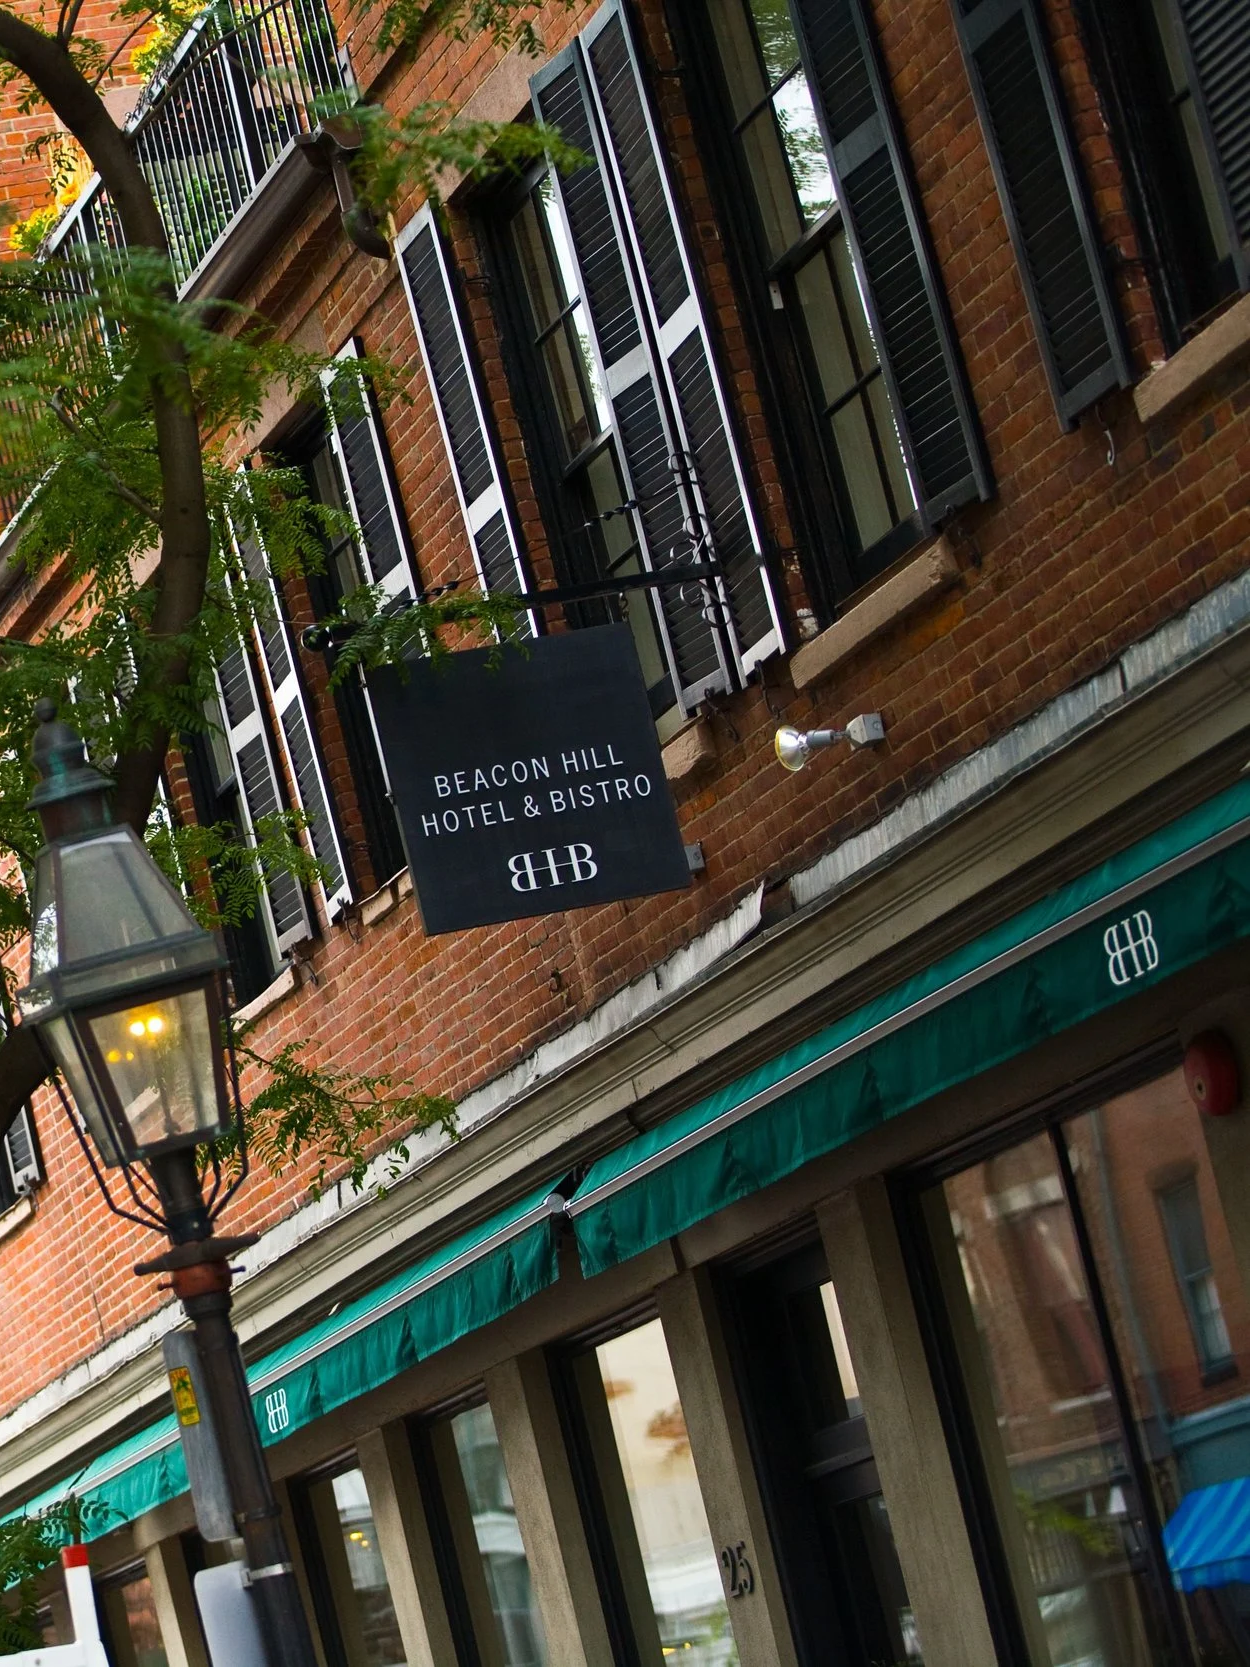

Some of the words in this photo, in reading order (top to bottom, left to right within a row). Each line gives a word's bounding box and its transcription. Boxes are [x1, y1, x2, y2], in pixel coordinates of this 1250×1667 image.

[434, 756, 550, 797] BEACON
[561, 744, 623, 774] HILL
[421, 801, 514, 836] HOTEL
[523, 795, 541, 817] &
[549, 774, 651, 813] BISTRO
[721, 1540, 754, 1598] 25
